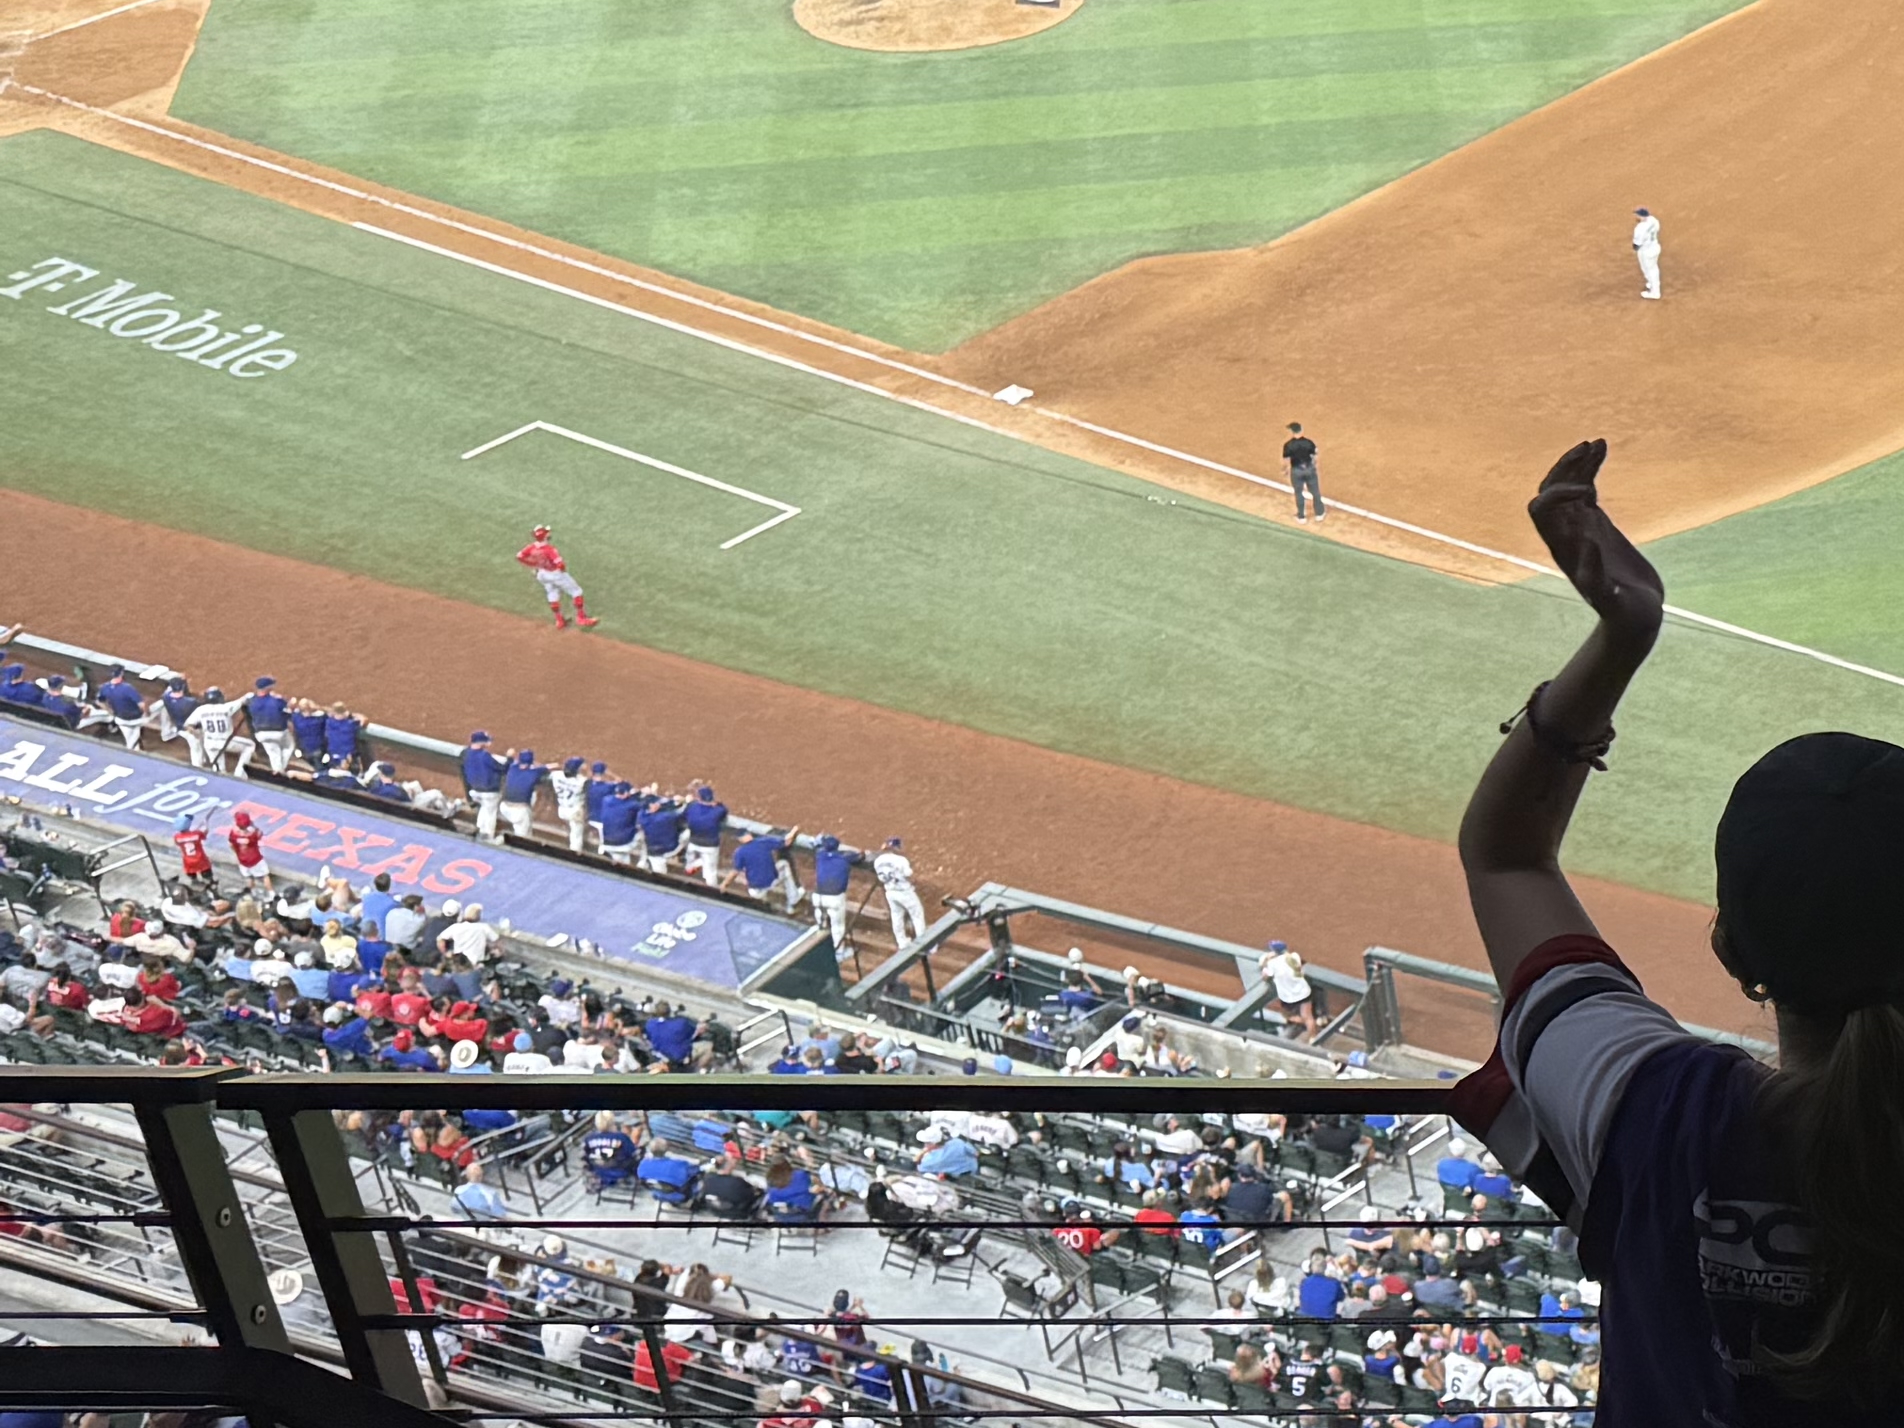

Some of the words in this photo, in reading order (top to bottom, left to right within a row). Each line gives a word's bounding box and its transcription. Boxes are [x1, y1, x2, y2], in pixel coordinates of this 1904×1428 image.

[0, 740, 134, 805] ALL
[93, 774, 233, 825] for
[213, 800, 494, 895] TEXAS
[1291, 1376, 1307, 1397] 5
